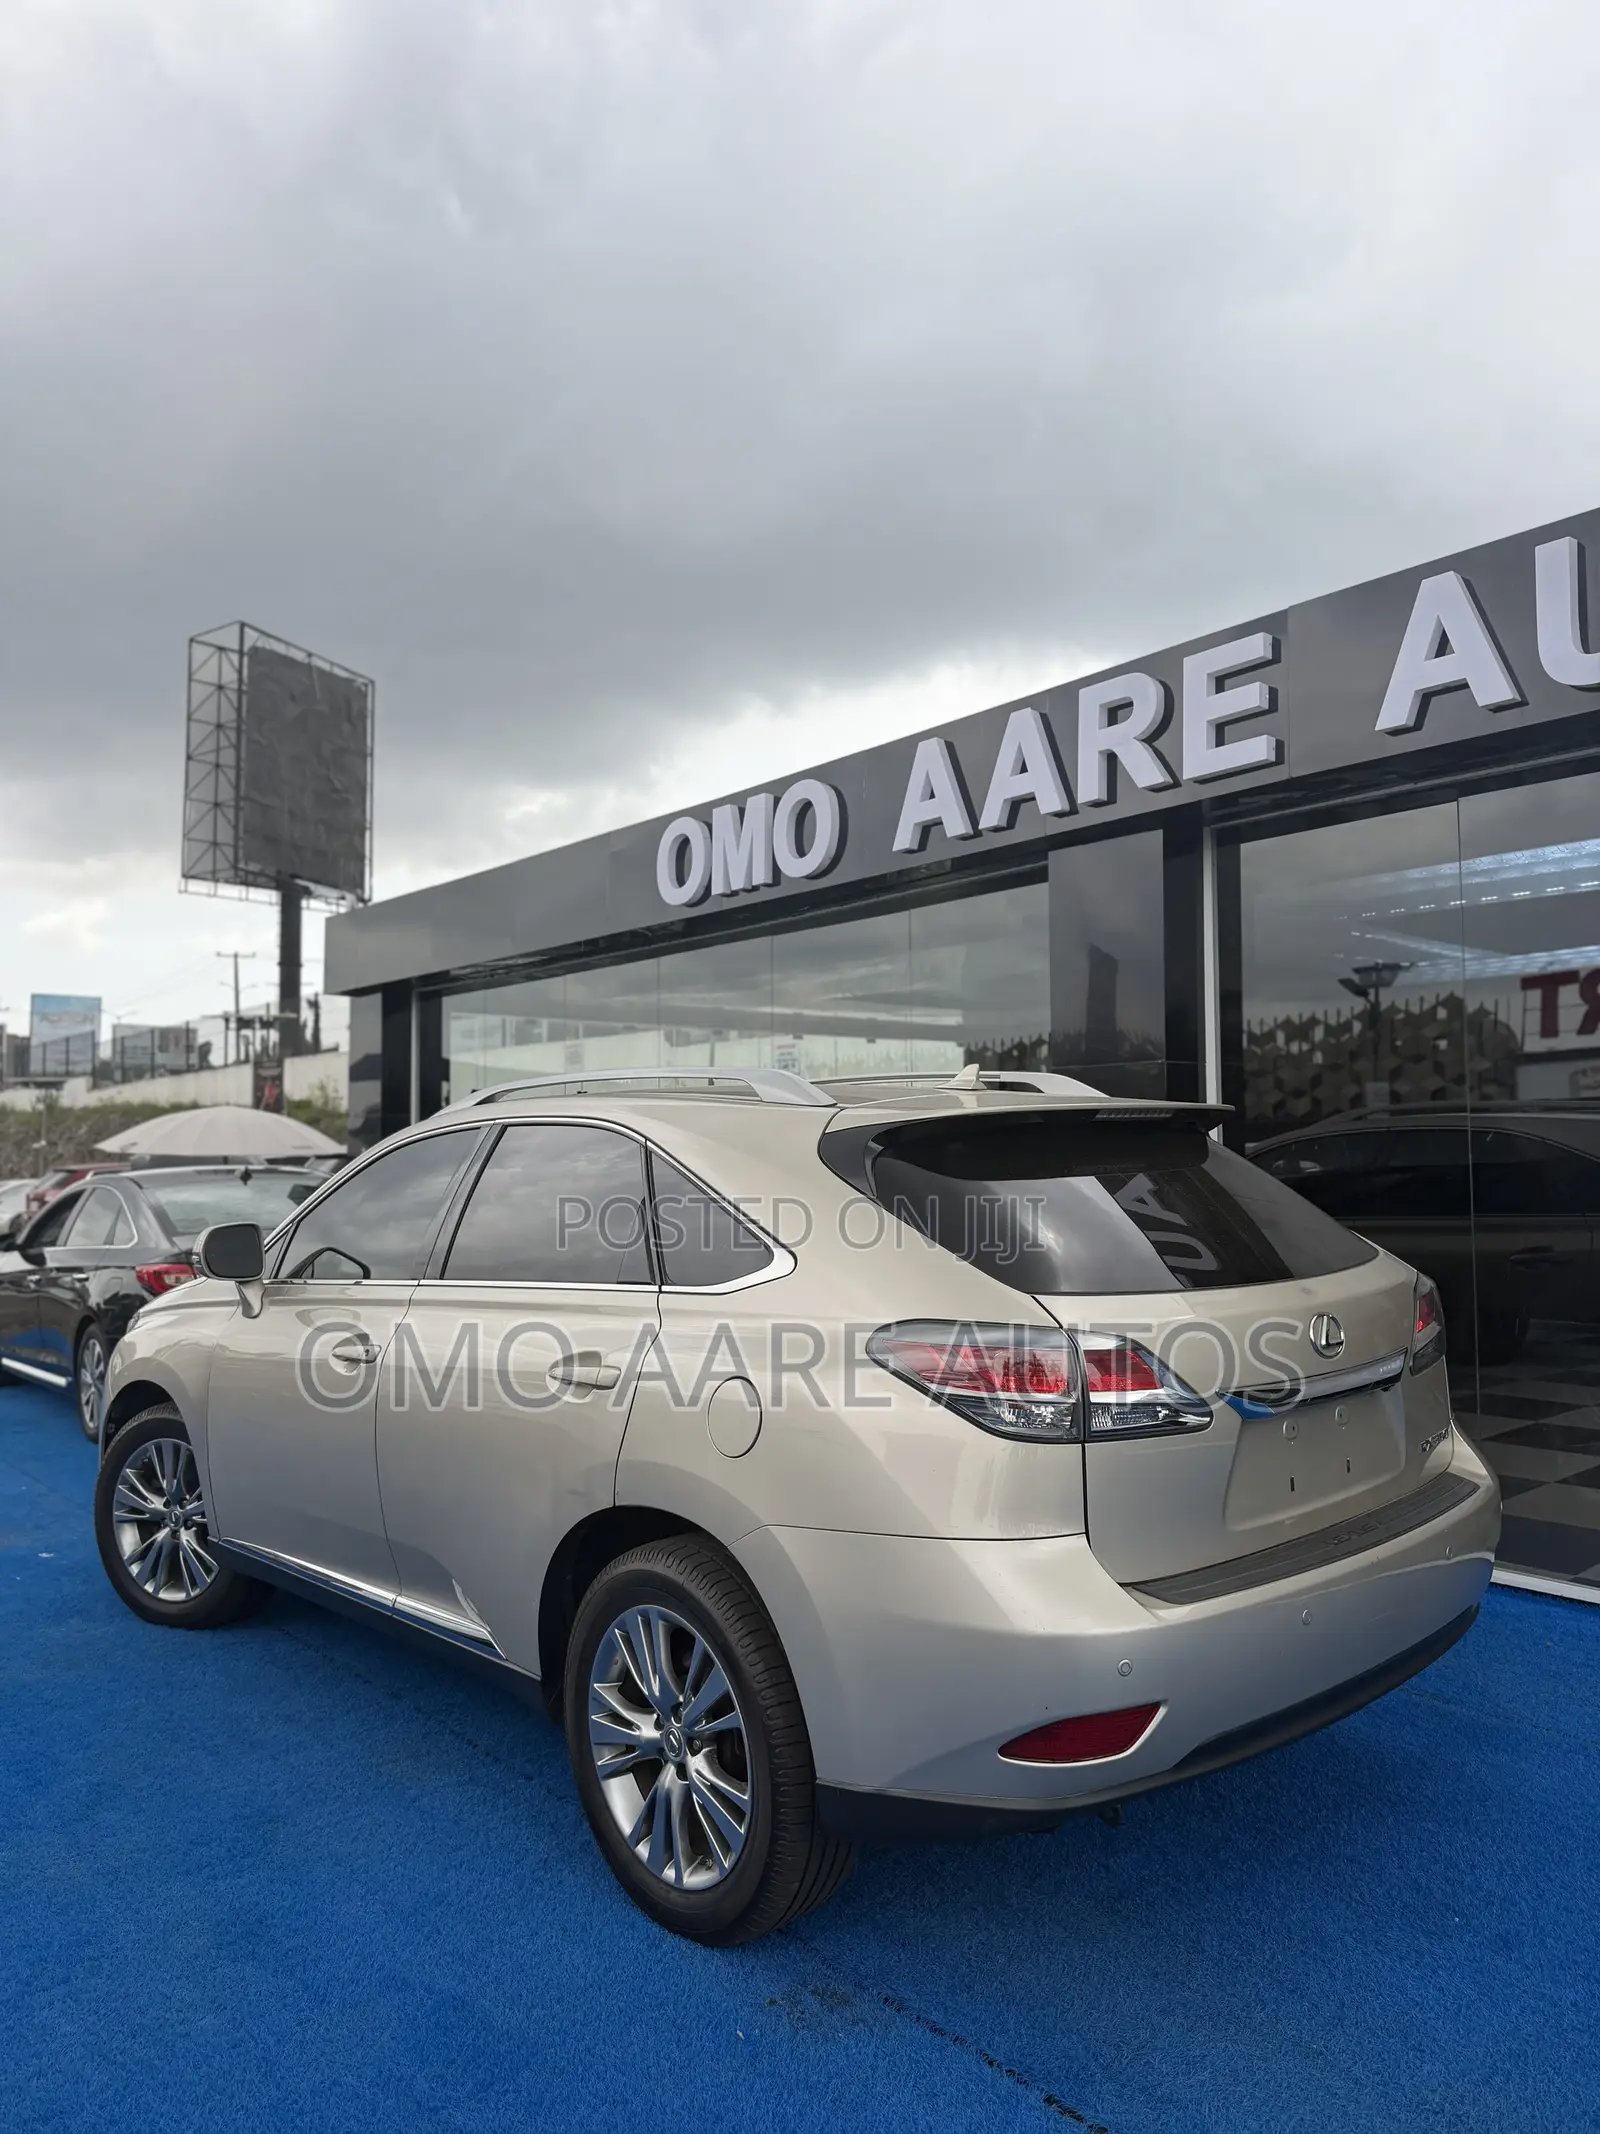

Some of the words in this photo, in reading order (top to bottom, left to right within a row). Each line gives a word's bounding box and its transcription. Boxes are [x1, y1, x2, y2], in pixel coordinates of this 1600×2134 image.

[656, 778, 842, 907] OMO
[892, 632, 1284, 853] AARE
[1375, 536, 1600, 736] AU
